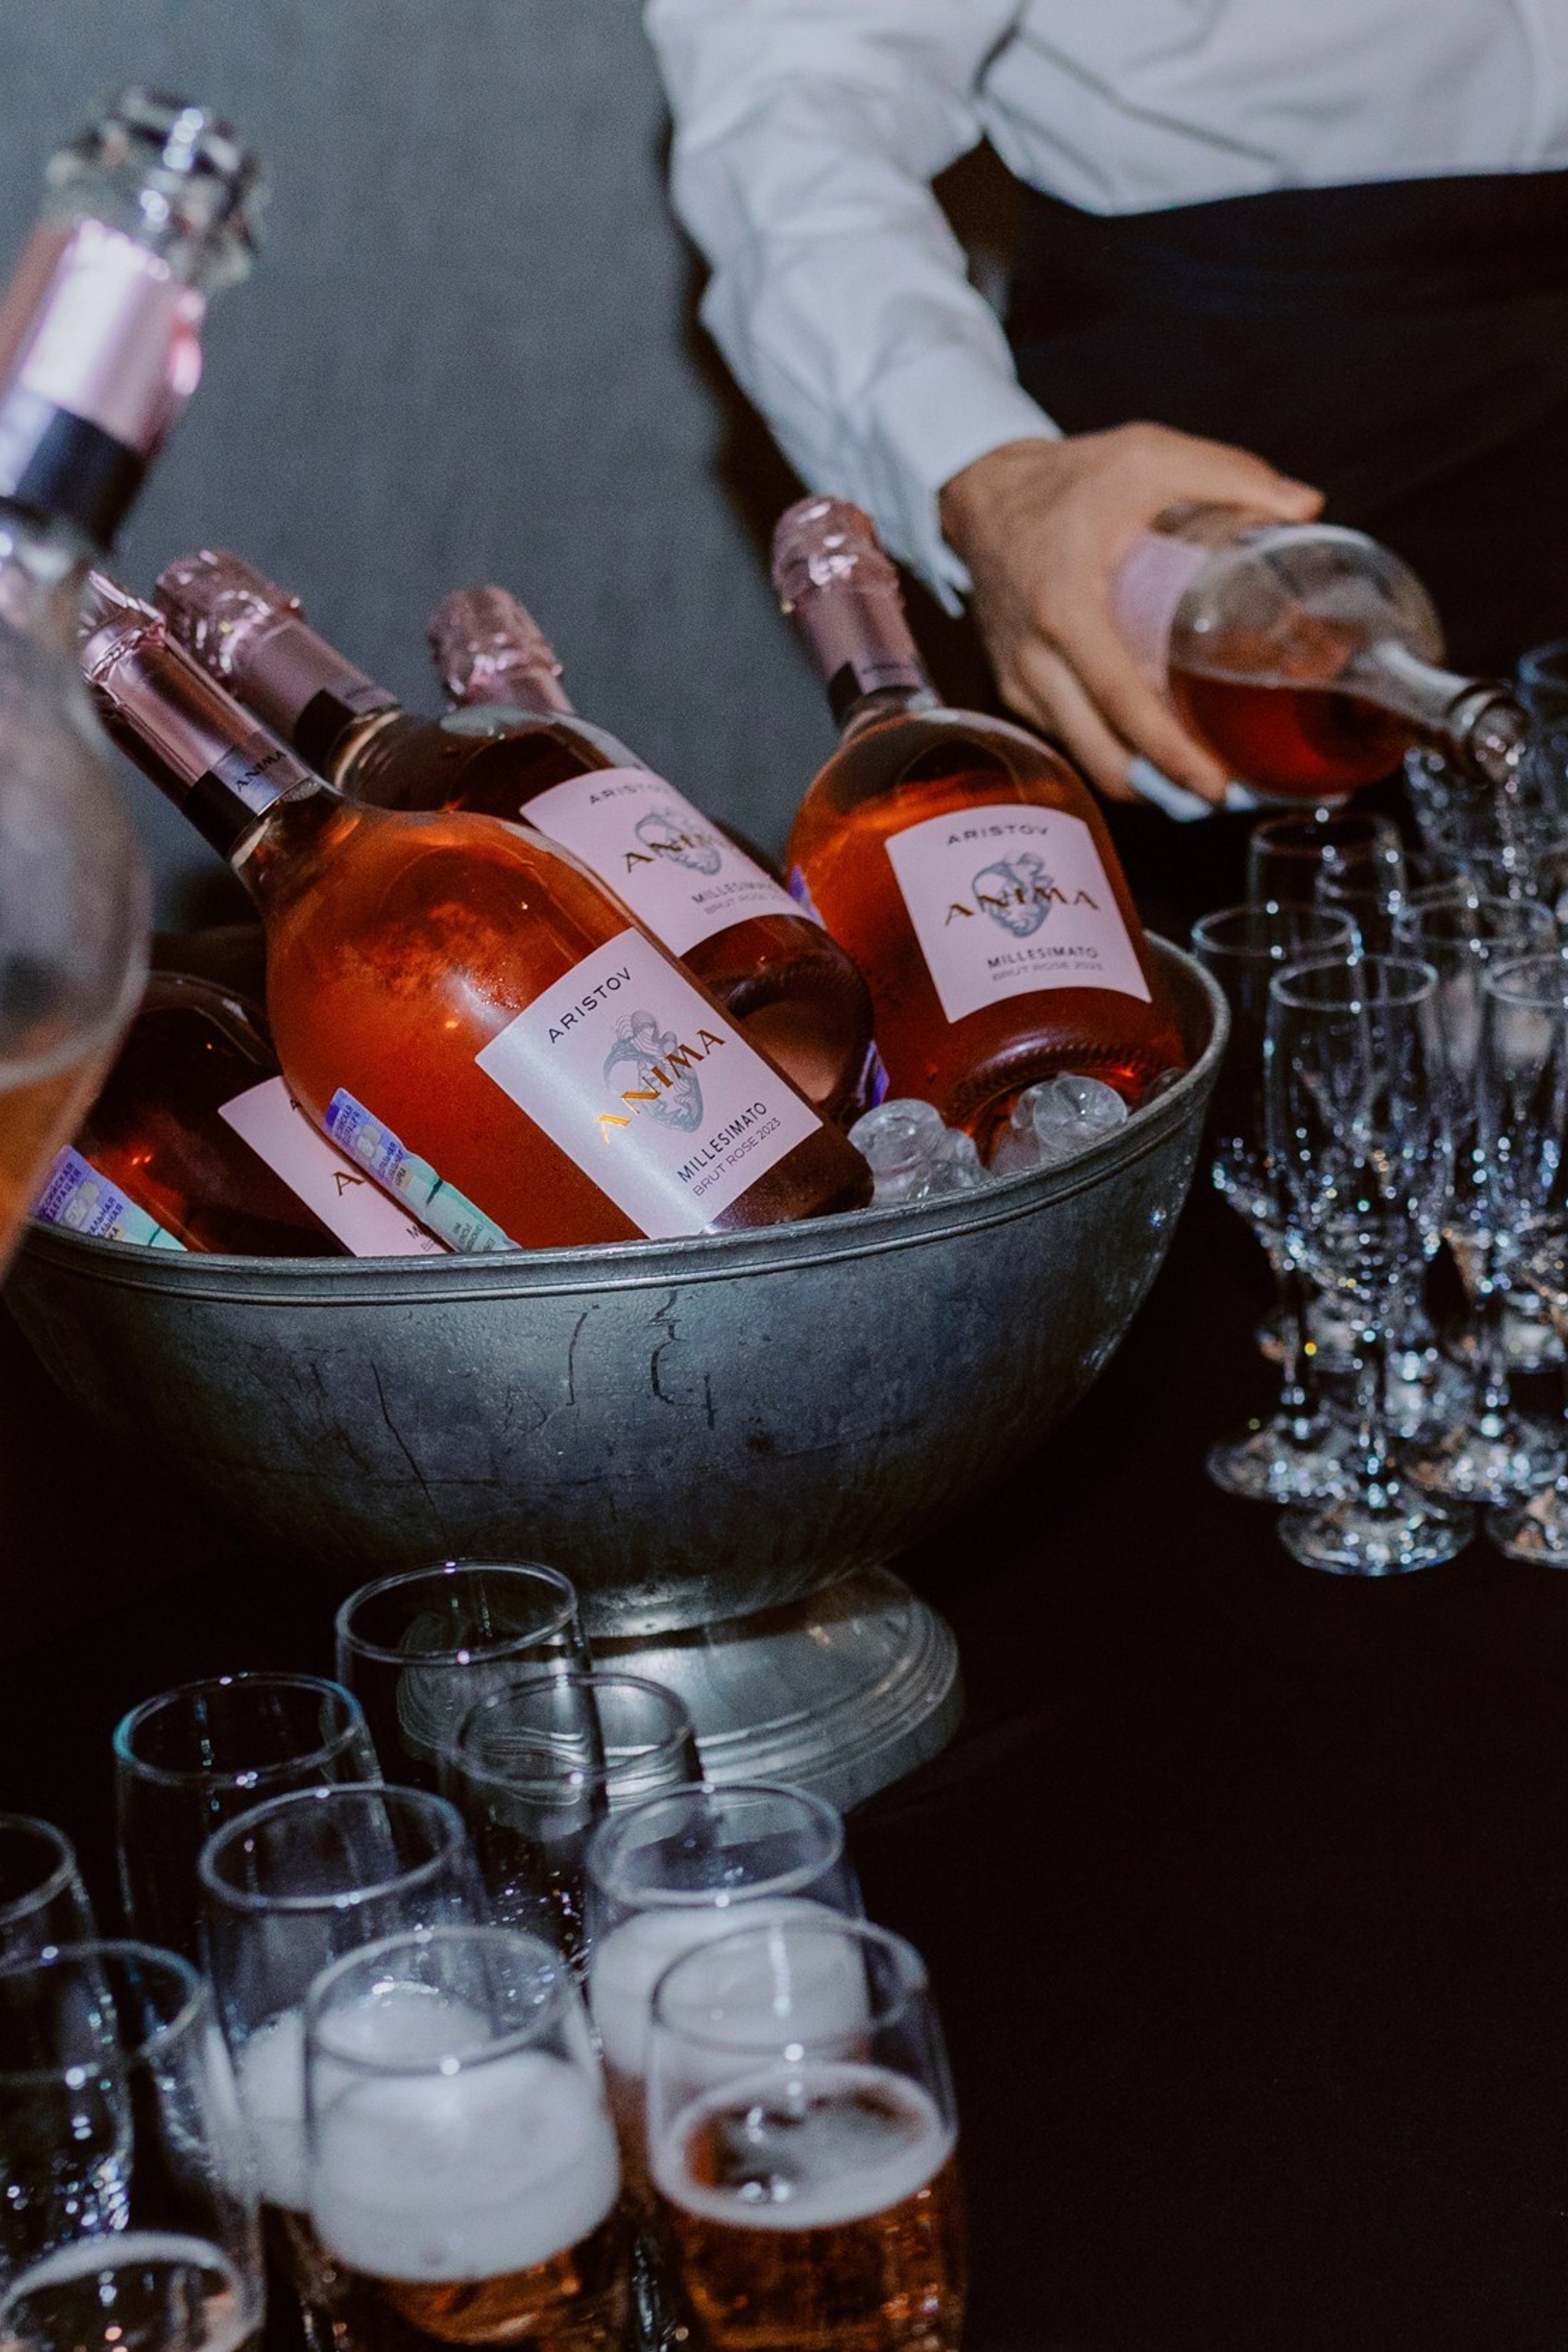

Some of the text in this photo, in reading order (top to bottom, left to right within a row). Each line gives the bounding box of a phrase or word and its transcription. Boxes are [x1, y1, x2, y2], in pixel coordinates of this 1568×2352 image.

[235, 750, 287, 793] ANIMA
[946, 824, 1049, 846] ARISTOV
[944, 886, 1099, 927] ANIMA
[987, 946, 1098, 969] MILLESIMATO
[548, 966, 633, 1044] ARISTOV
[596, 1028, 726, 1148] ANIMA
[677, 1102, 767, 1183] MILLESIMATO
[693, 1117, 782, 1196] BRUT ROSE 2023
